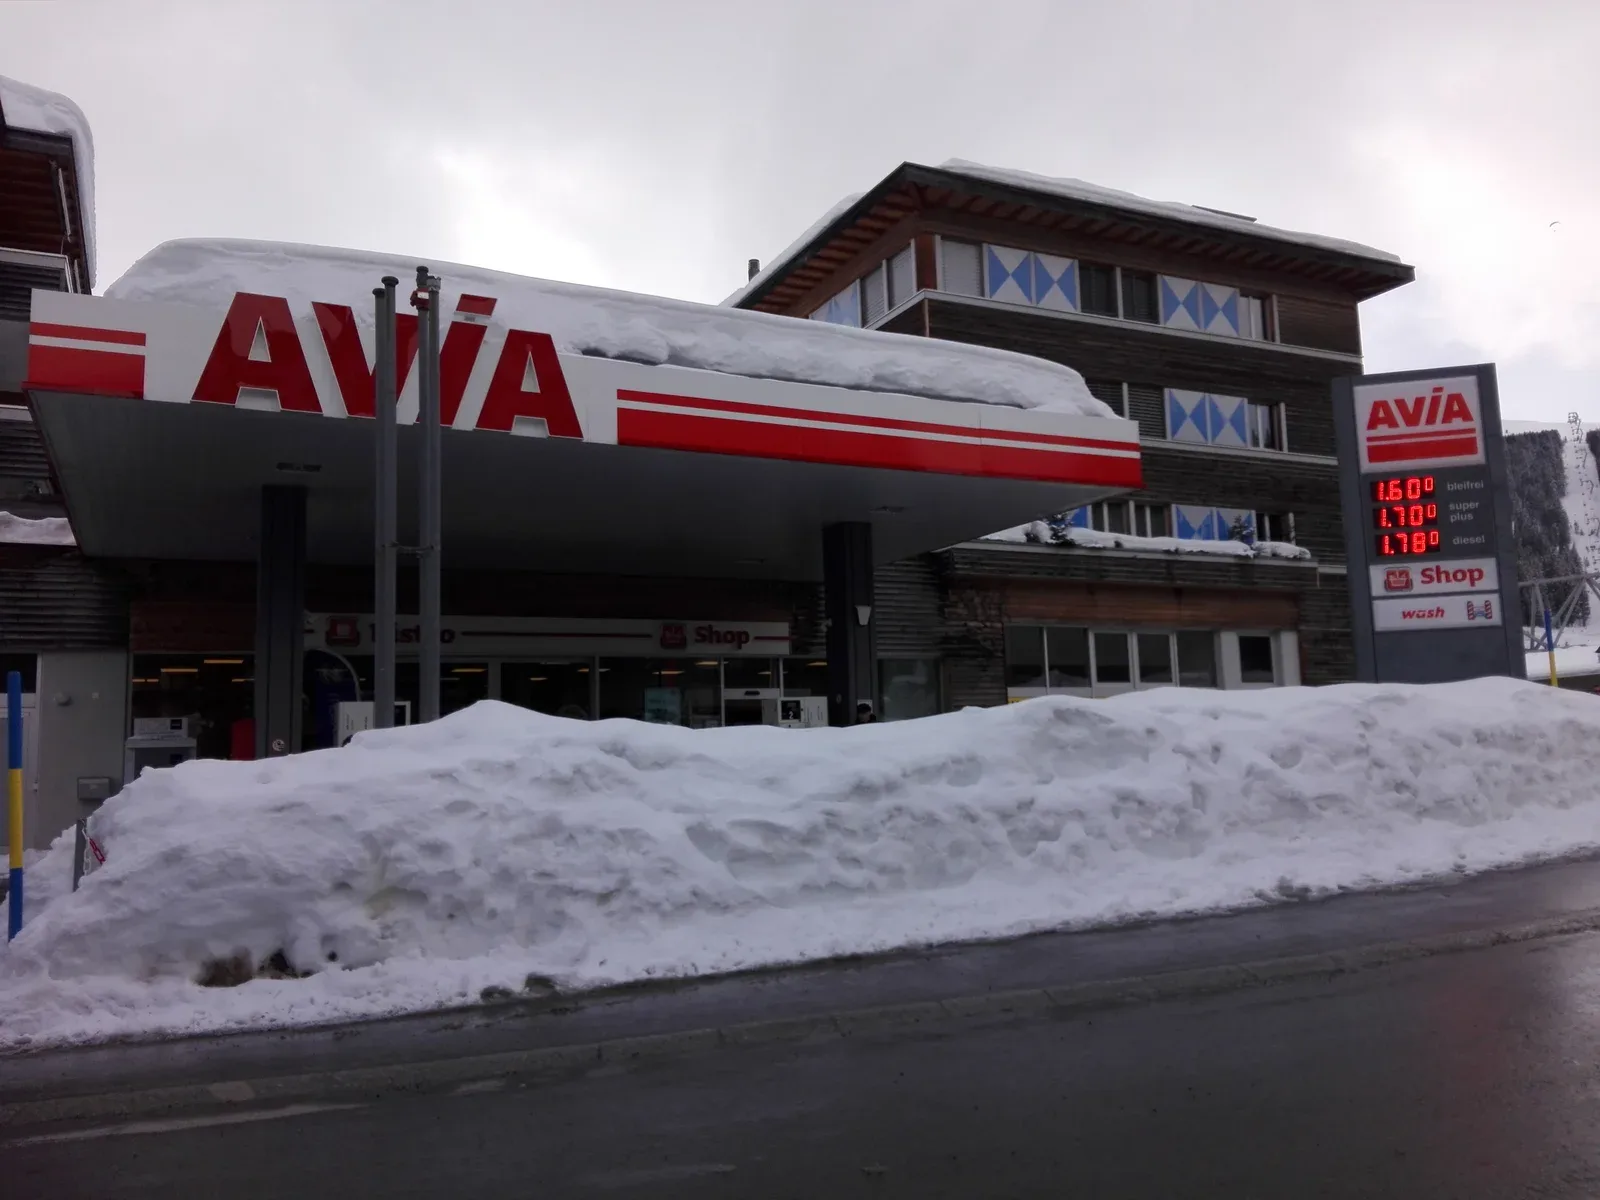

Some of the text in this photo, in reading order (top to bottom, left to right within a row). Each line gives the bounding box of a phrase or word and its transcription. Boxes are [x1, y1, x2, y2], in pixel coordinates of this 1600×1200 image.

[1446, 480, 1484, 491] bleifrei
[1449, 501, 1479, 512] super
[1450, 511, 1474, 523] plus
[1452, 534, 1485, 545] diesel
[1420, 564, 1484, 587] Shop
[1401, 607, 1445, 620] wash
[694, 624, 750, 649] Shop
